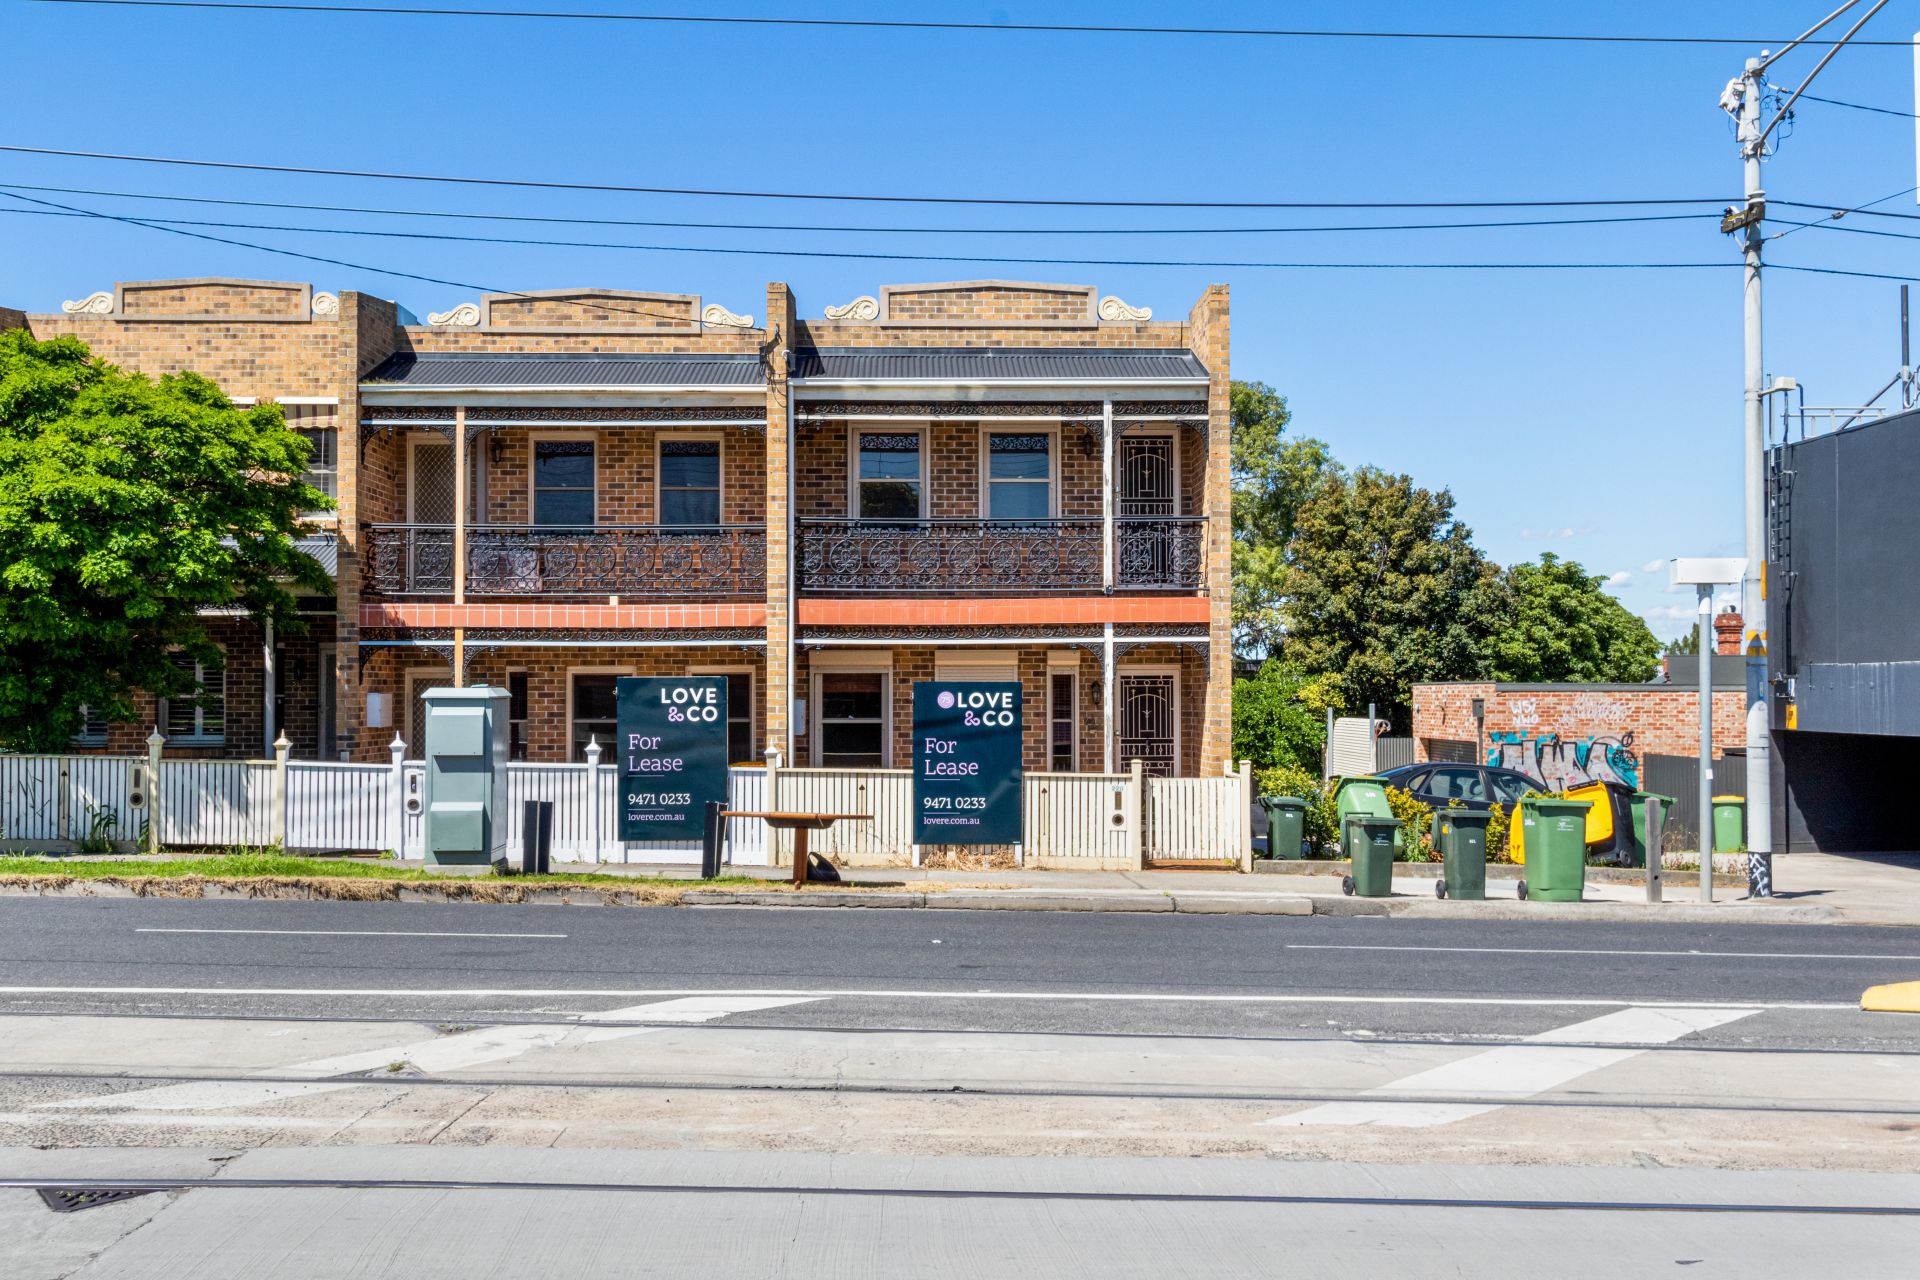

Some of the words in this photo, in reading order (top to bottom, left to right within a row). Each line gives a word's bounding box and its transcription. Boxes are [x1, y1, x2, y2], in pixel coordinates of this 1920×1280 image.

[661, 688, 717, 704] LOVE
[957, 692, 1013, 708] LOVE
[668, 706, 718, 722] &CO
[964, 710, 1014, 726] &CO
[628, 734, 661, 750] For
[924, 738, 957, 754] For
[628, 756, 683, 772] Lease
[924, 760, 979, 775] Lease
[628, 793, 656, 805] 9471
[660, 793, 691, 805] 0233
[923, 797, 952, 809] 9471
[955, 797, 986, 809] 0233
[628, 813, 685, 821] lovere.com.au
[923, 816, 980, 825] lovere.com.au
